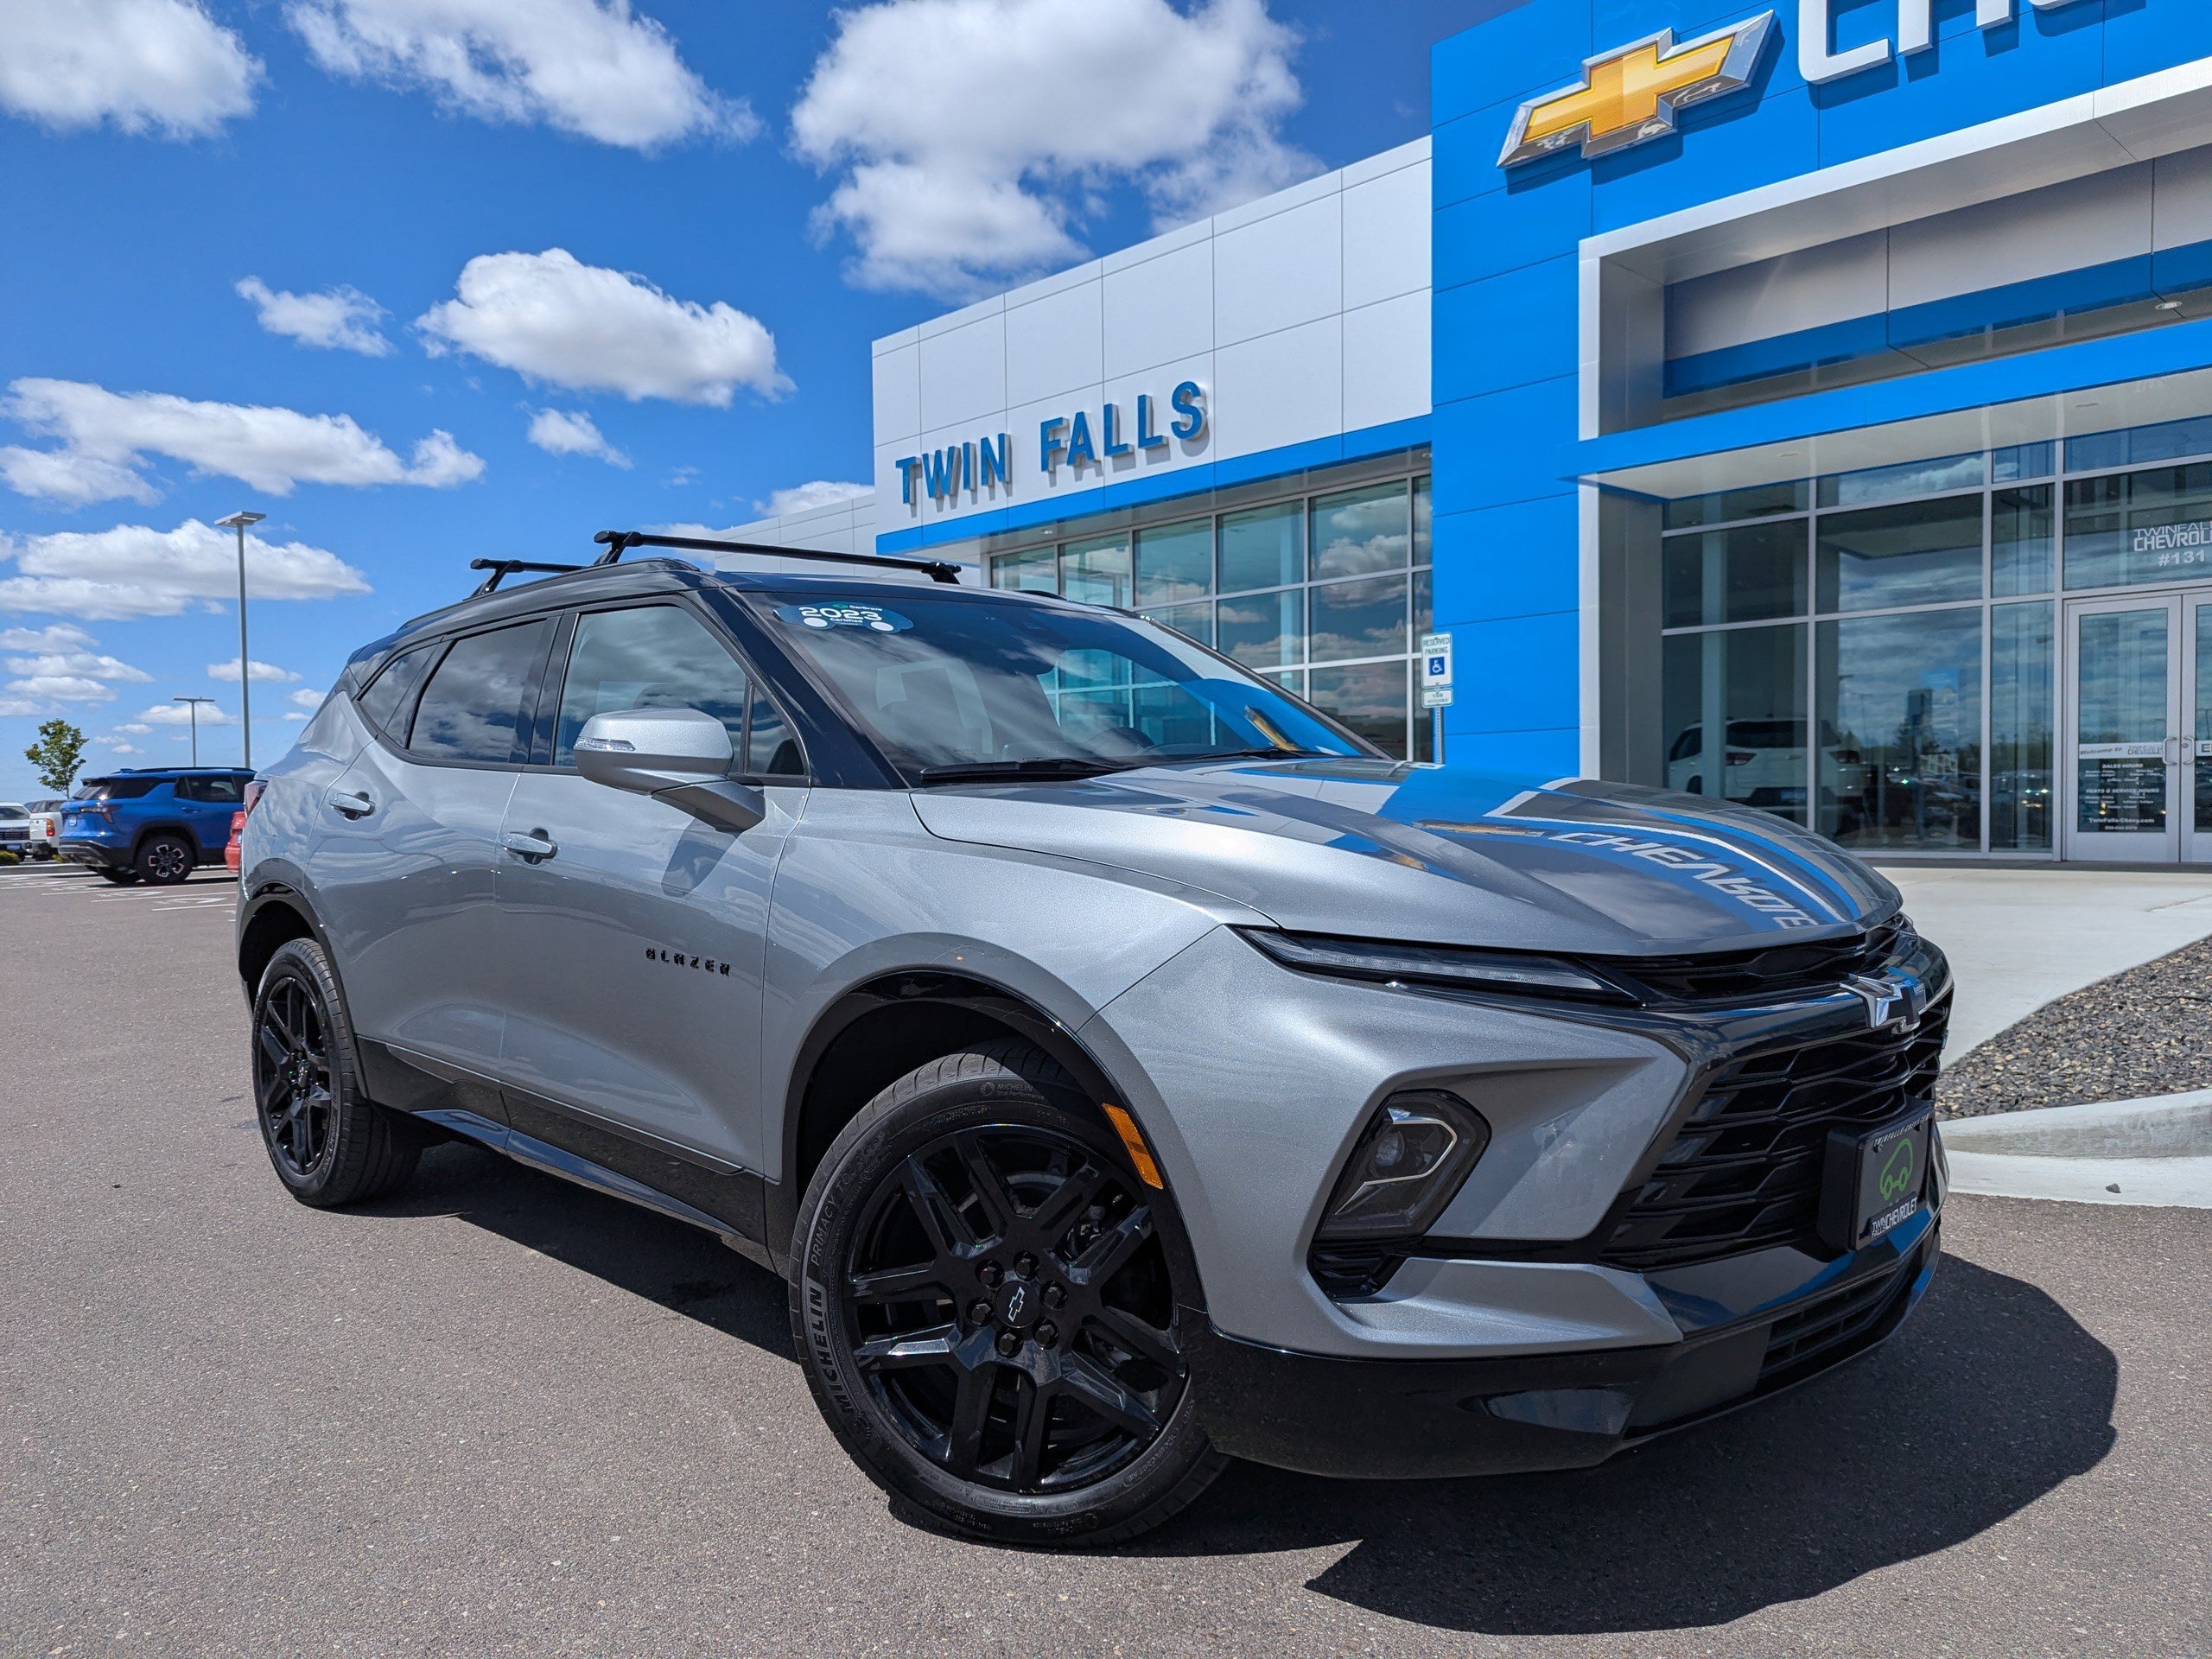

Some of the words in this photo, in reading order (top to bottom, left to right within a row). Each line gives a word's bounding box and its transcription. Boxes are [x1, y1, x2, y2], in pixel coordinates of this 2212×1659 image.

[896, 432, 1012, 505] TWIN
[1040, 380, 1209, 473] FALLS
[2134, 520, 2212, 537] TWINFAL
[2133, 530, 2212, 552] CHEVROL
[2158, 550, 2205, 567] #131
[798, 607, 883, 621] 2023
[1422, 638, 1450, 647] RESERVED
[1424, 646, 1448, 655] PARKING
[645, 948, 730, 976] BLAZER
[997, 1084, 1033, 1092] MICHELIN
[1886, 1197, 1918, 1230] CHEVROLET
[810, 1194, 836, 1267] PRIMACY
[810, 1286, 854, 1414] MICHELIN
